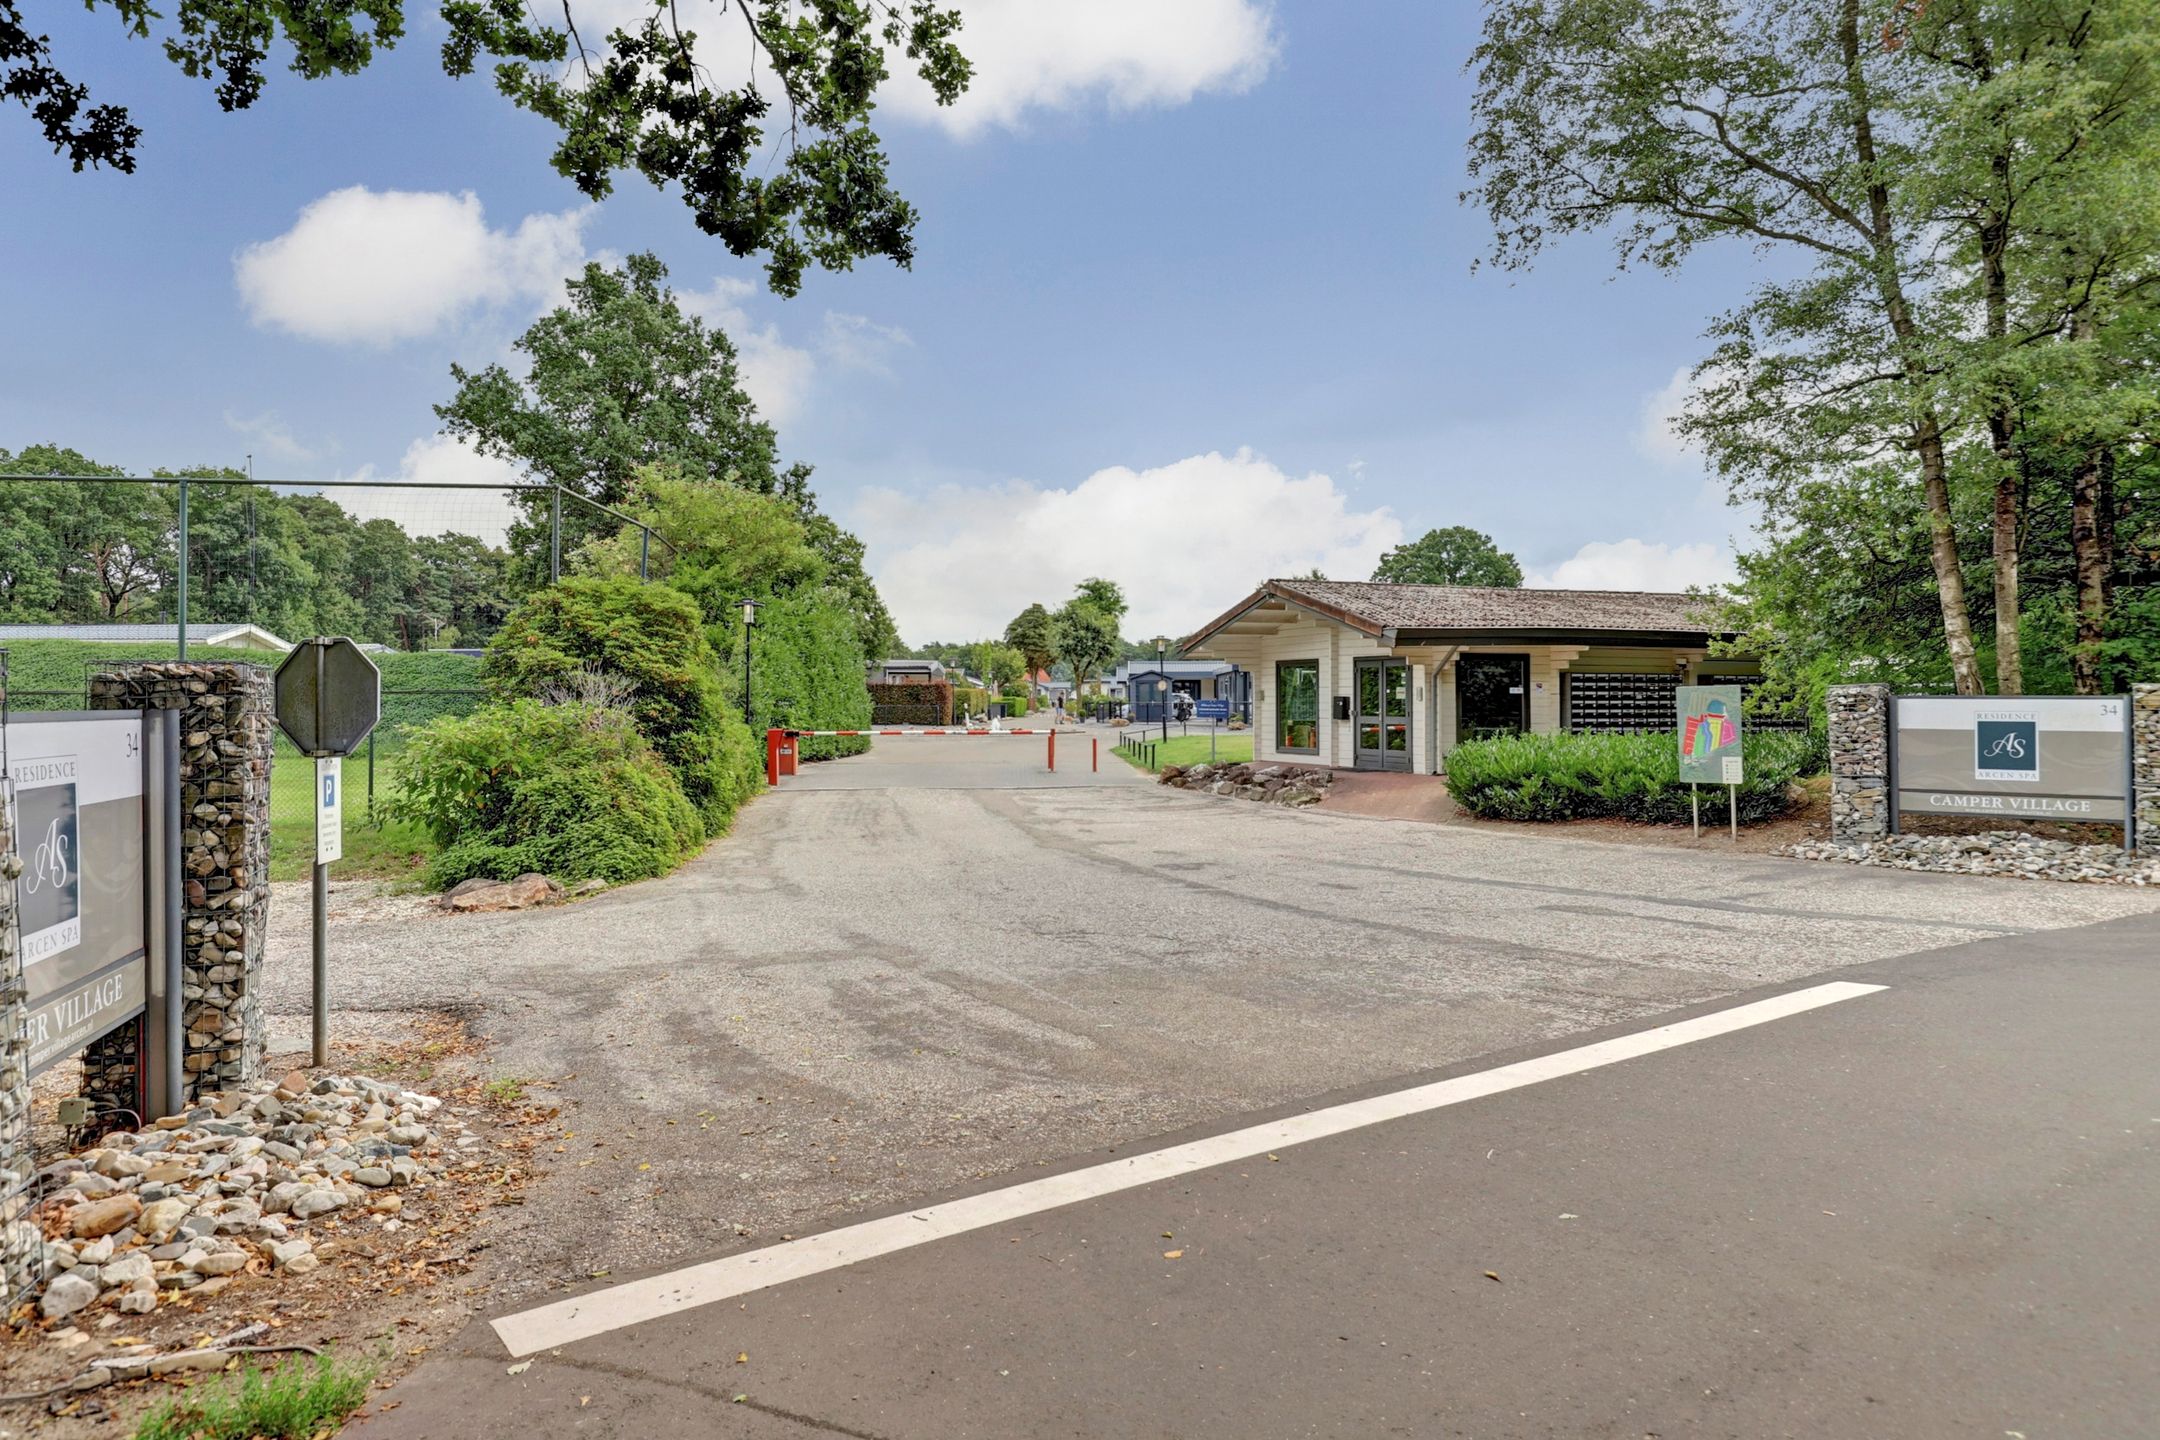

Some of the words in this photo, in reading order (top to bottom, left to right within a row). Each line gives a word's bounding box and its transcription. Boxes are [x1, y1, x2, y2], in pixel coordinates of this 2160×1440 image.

[1976, 712, 2037, 720] RESIDENCE
[2100, 704, 2119, 716] 34
[126, 732, 139, 758] 34
[14, 761, 76, 783] RESIDENCE
[1977, 771, 2015, 779] ARCEN
[1930, 794, 2003, 809] CAMPER
[2010, 798, 2092, 812] VILLAGE
[61, 924, 79, 945] SPA
[54, 973, 123, 1034] VILLAGE
